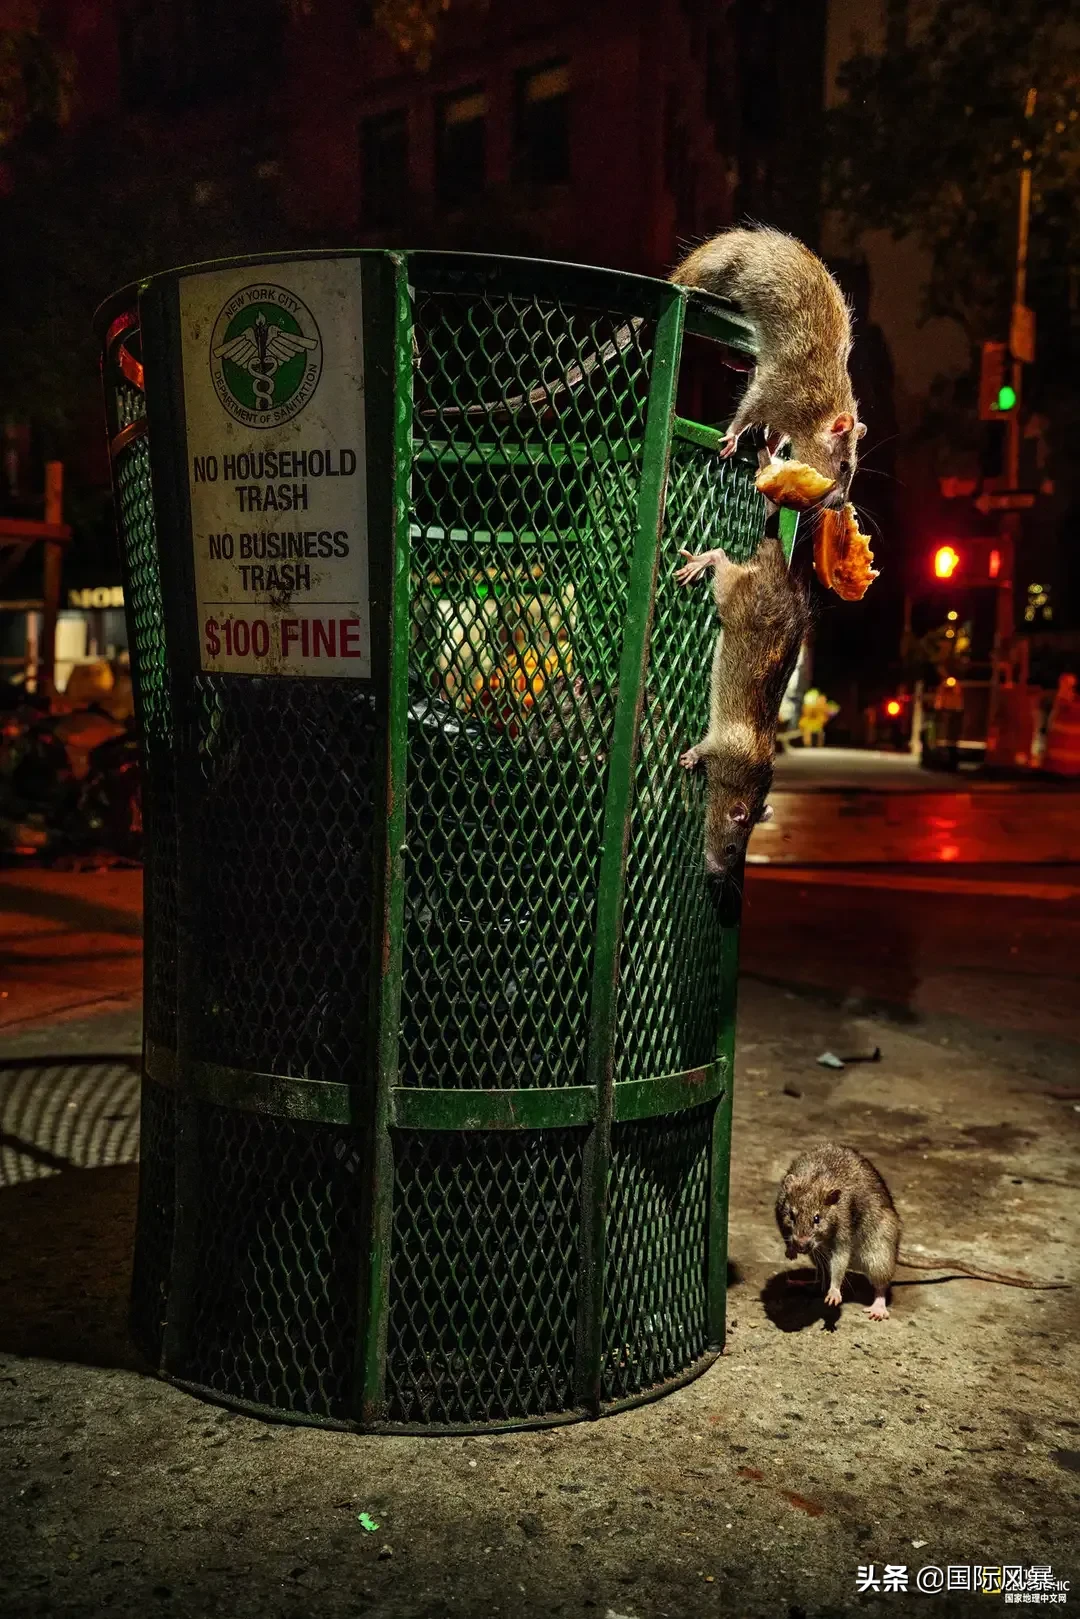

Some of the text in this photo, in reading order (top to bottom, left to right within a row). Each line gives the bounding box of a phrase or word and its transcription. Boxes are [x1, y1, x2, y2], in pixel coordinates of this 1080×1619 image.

[225, 289, 301, 319] NEW YORK CITY
[214, 363, 317, 424] DEPARTMENT OF SANITATION
[193, 449, 357, 483] NO HOUSEHOLD
[235, 483, 309, 513] TRASH
[208, 531, 350, 560] NO BUSINESS
[239, 564, 311, 591] TRASH
[205, 615, 361, 660] $100 FINE
